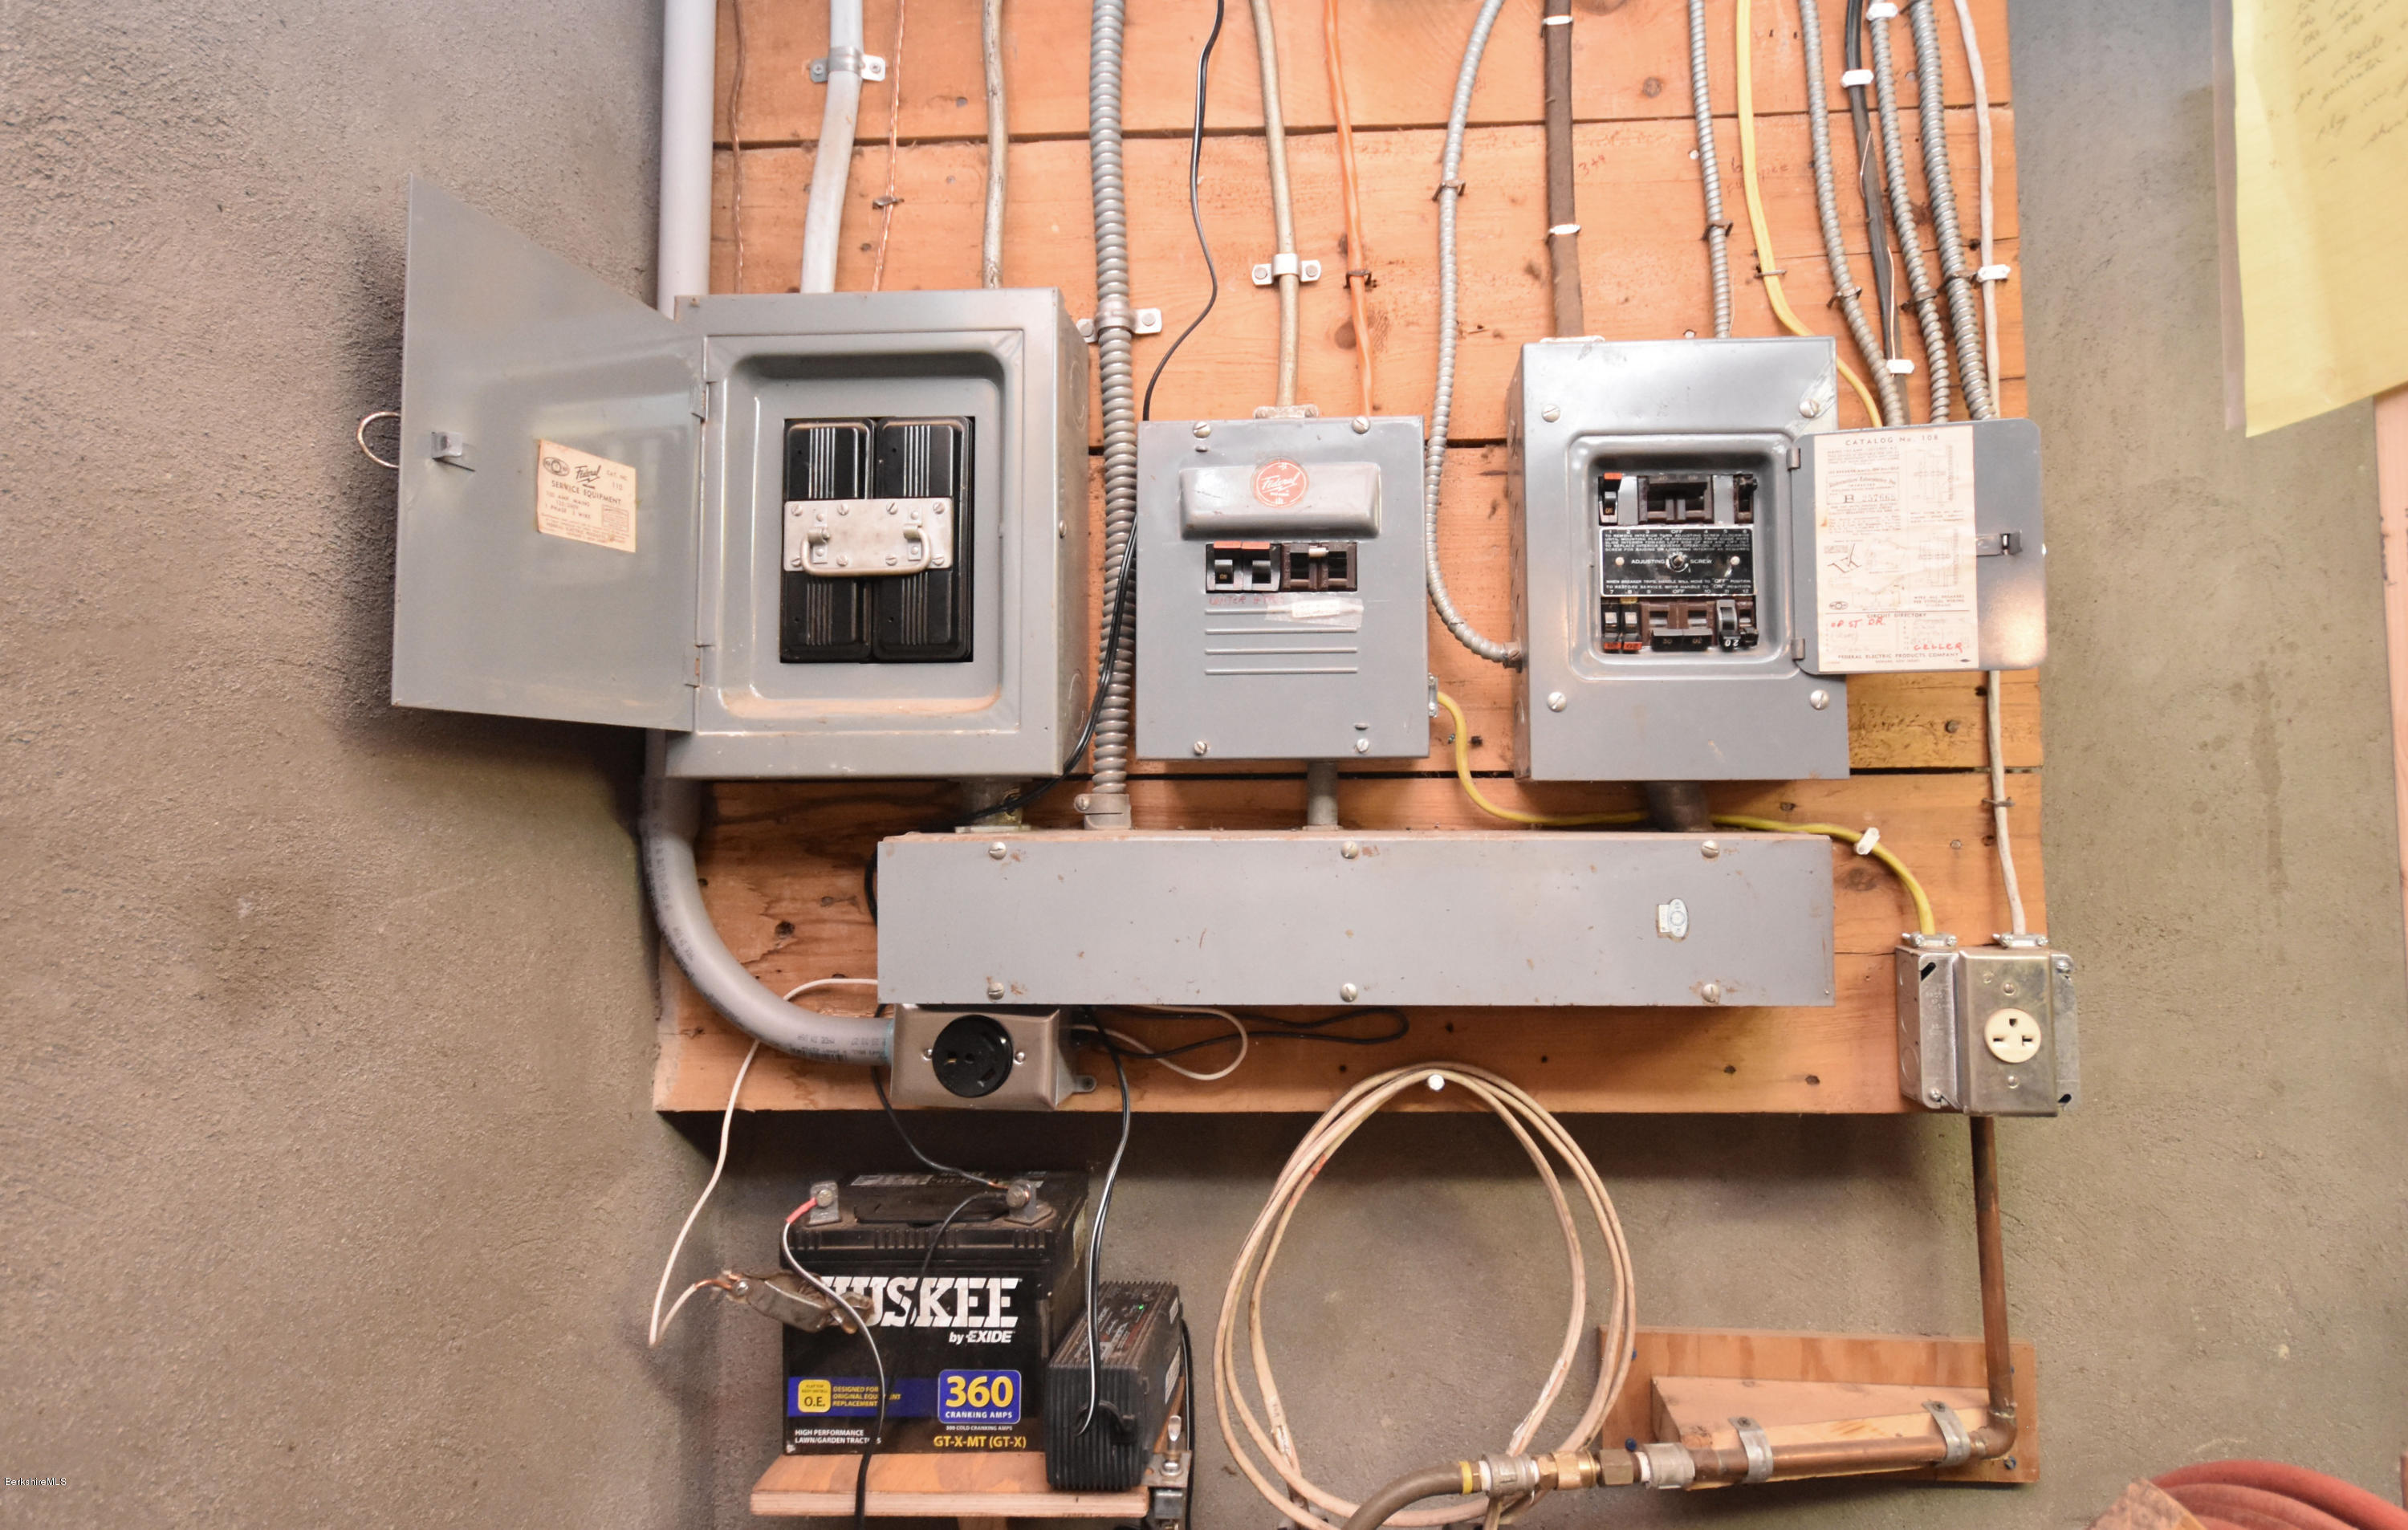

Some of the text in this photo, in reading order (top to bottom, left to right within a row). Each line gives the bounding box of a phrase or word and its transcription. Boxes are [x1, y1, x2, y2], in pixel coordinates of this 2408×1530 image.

[1845, 437, 1893, 446] CATALOG
[575, 465, 601, 479] Federal
[1261, 472, 1300, 490] Federal
[551, 480, 580, 494] SERVICE
[584, 489, 621, 505] EQUIPMENT
[949, 1330, 1013, 1345] by EXIDE
[946, 1375, 1014, 1408] 360
[804, 1396, 826, 1407] O.E.
[847, 1437, 881, 1445] TRACTS
[933, 1435, 1027, 1449] GT-X-MT (GT-X)
